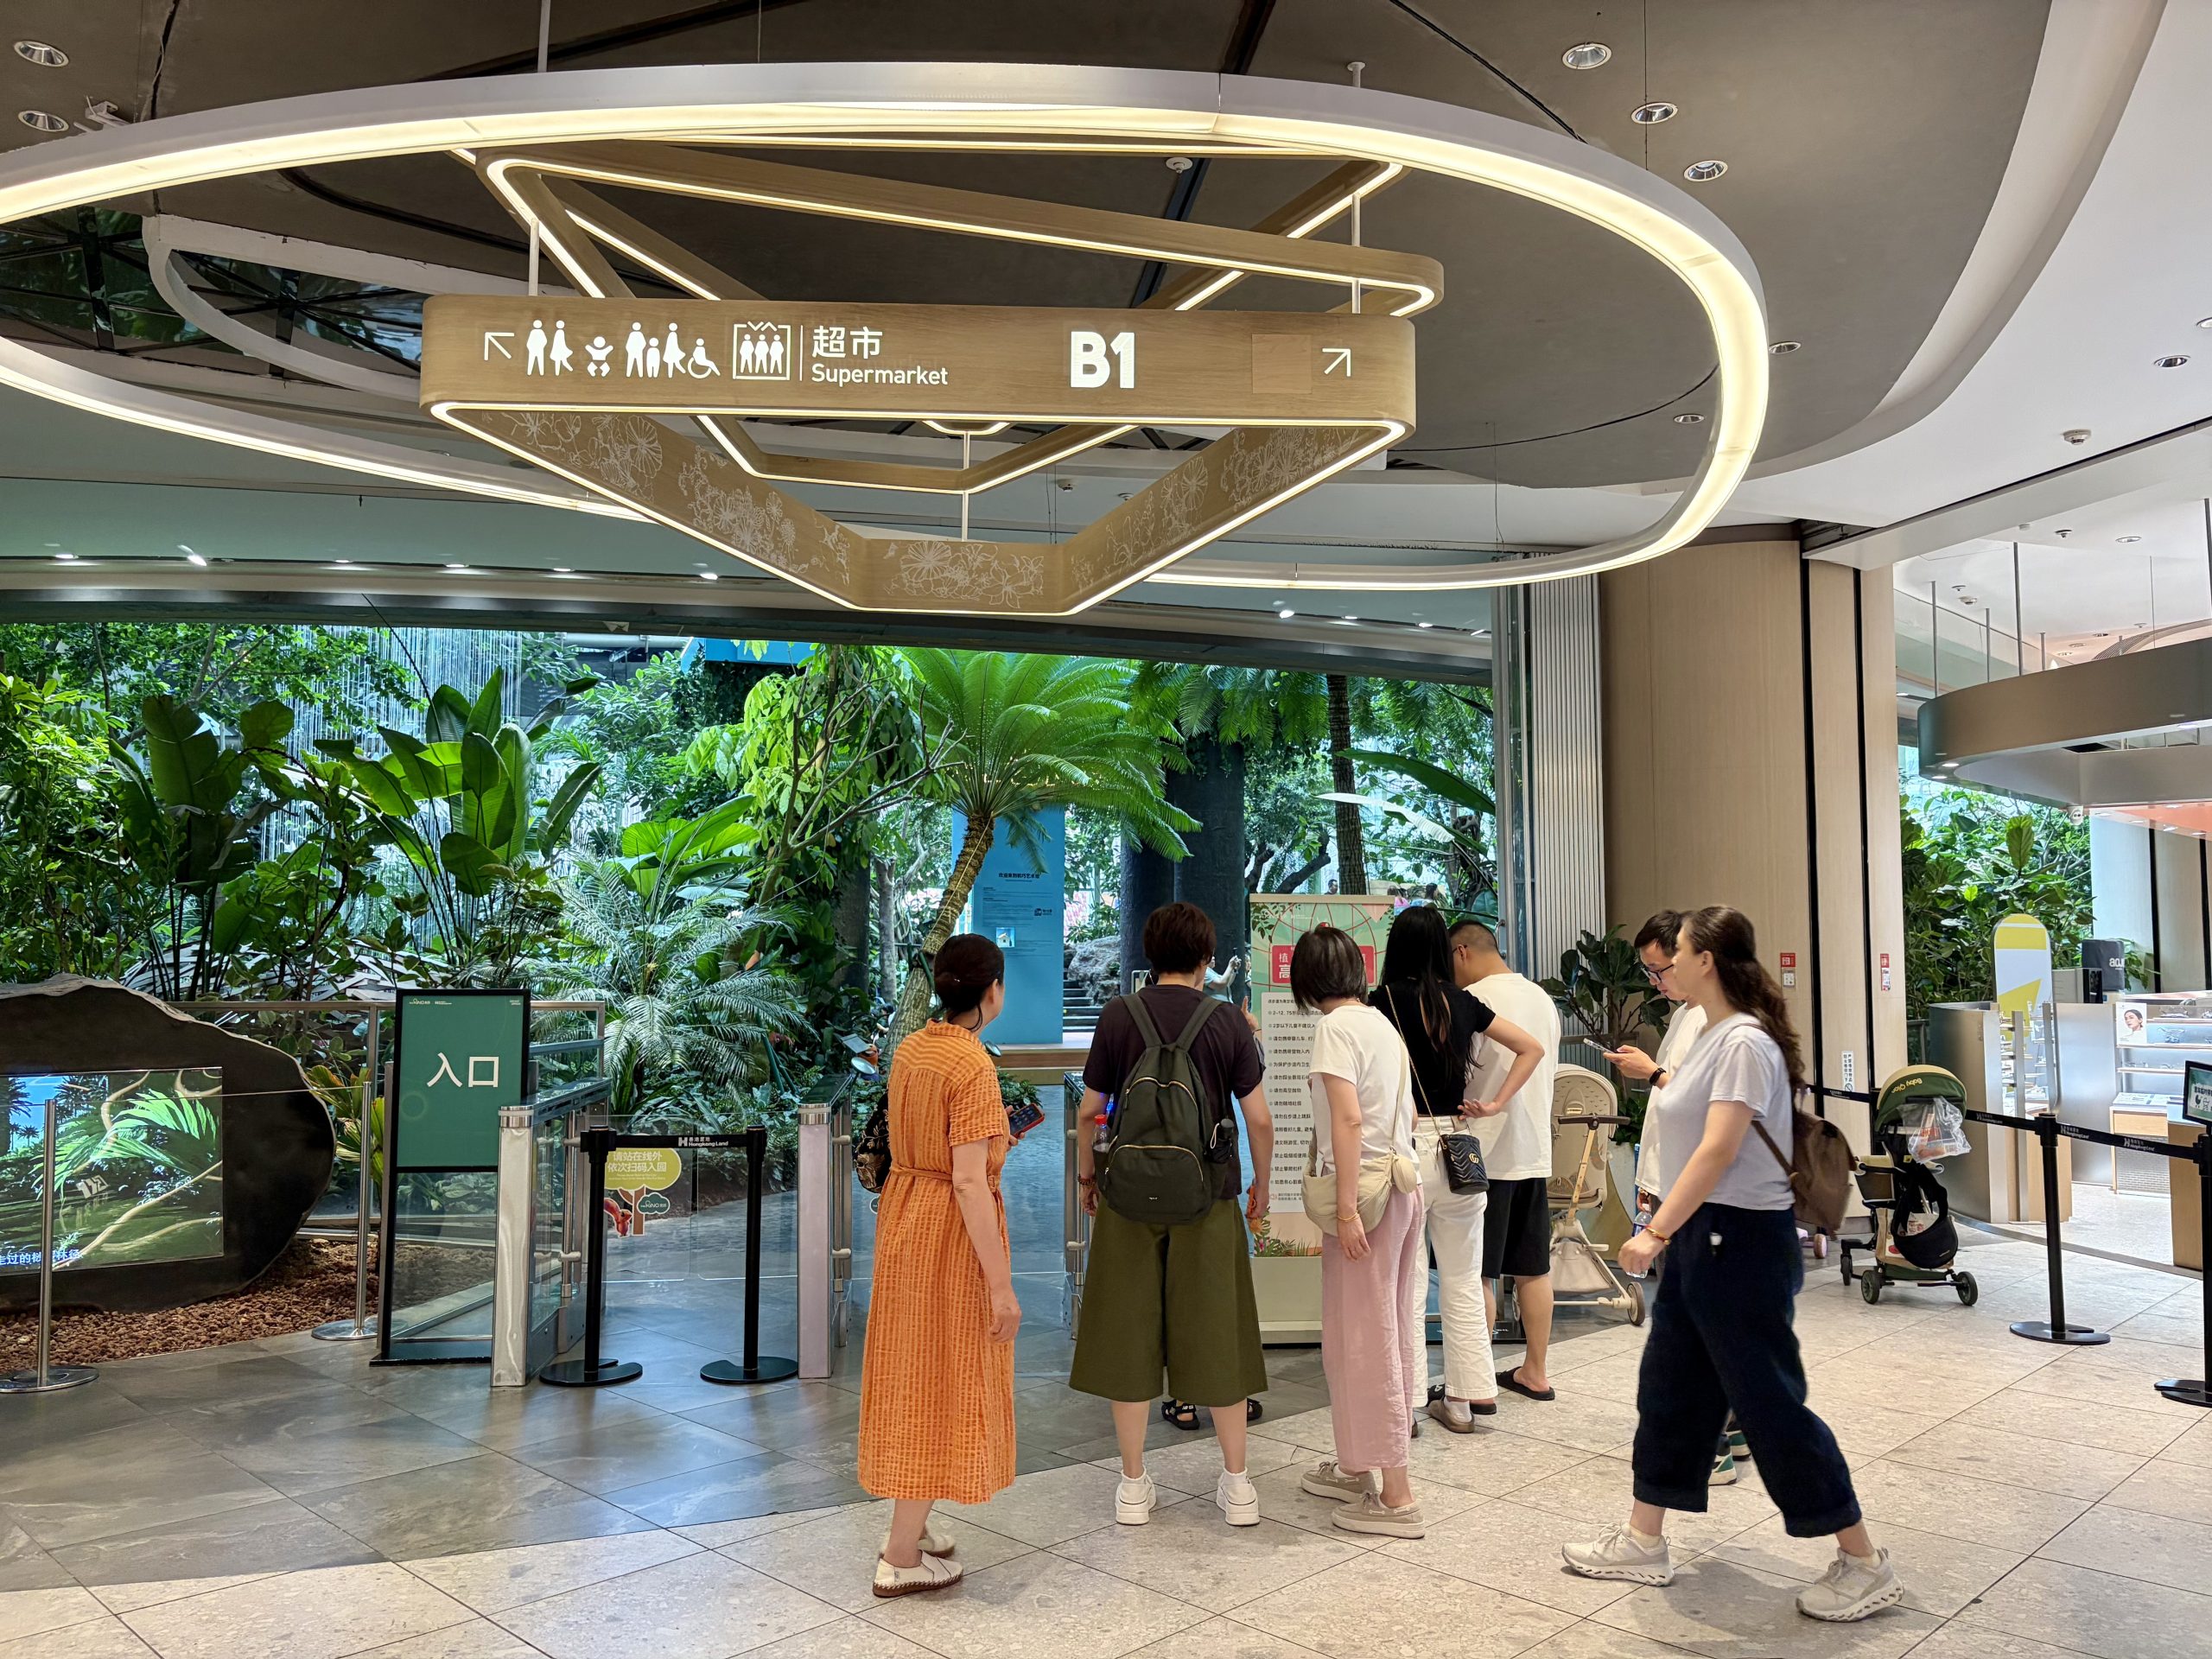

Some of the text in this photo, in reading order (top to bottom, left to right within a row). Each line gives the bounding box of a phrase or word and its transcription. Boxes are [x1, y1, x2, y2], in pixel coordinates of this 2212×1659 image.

[811, 325, 883, 359] 超市
[1071, 331, 1135, 389] B1
[811, 363, 948, 387] Supermarket
[427, 1052, 499, 1088] 入口
[607, 1161, 667, 1173] 依次扫码入园
[613, 1151, 663, 1161] 请站在线外
